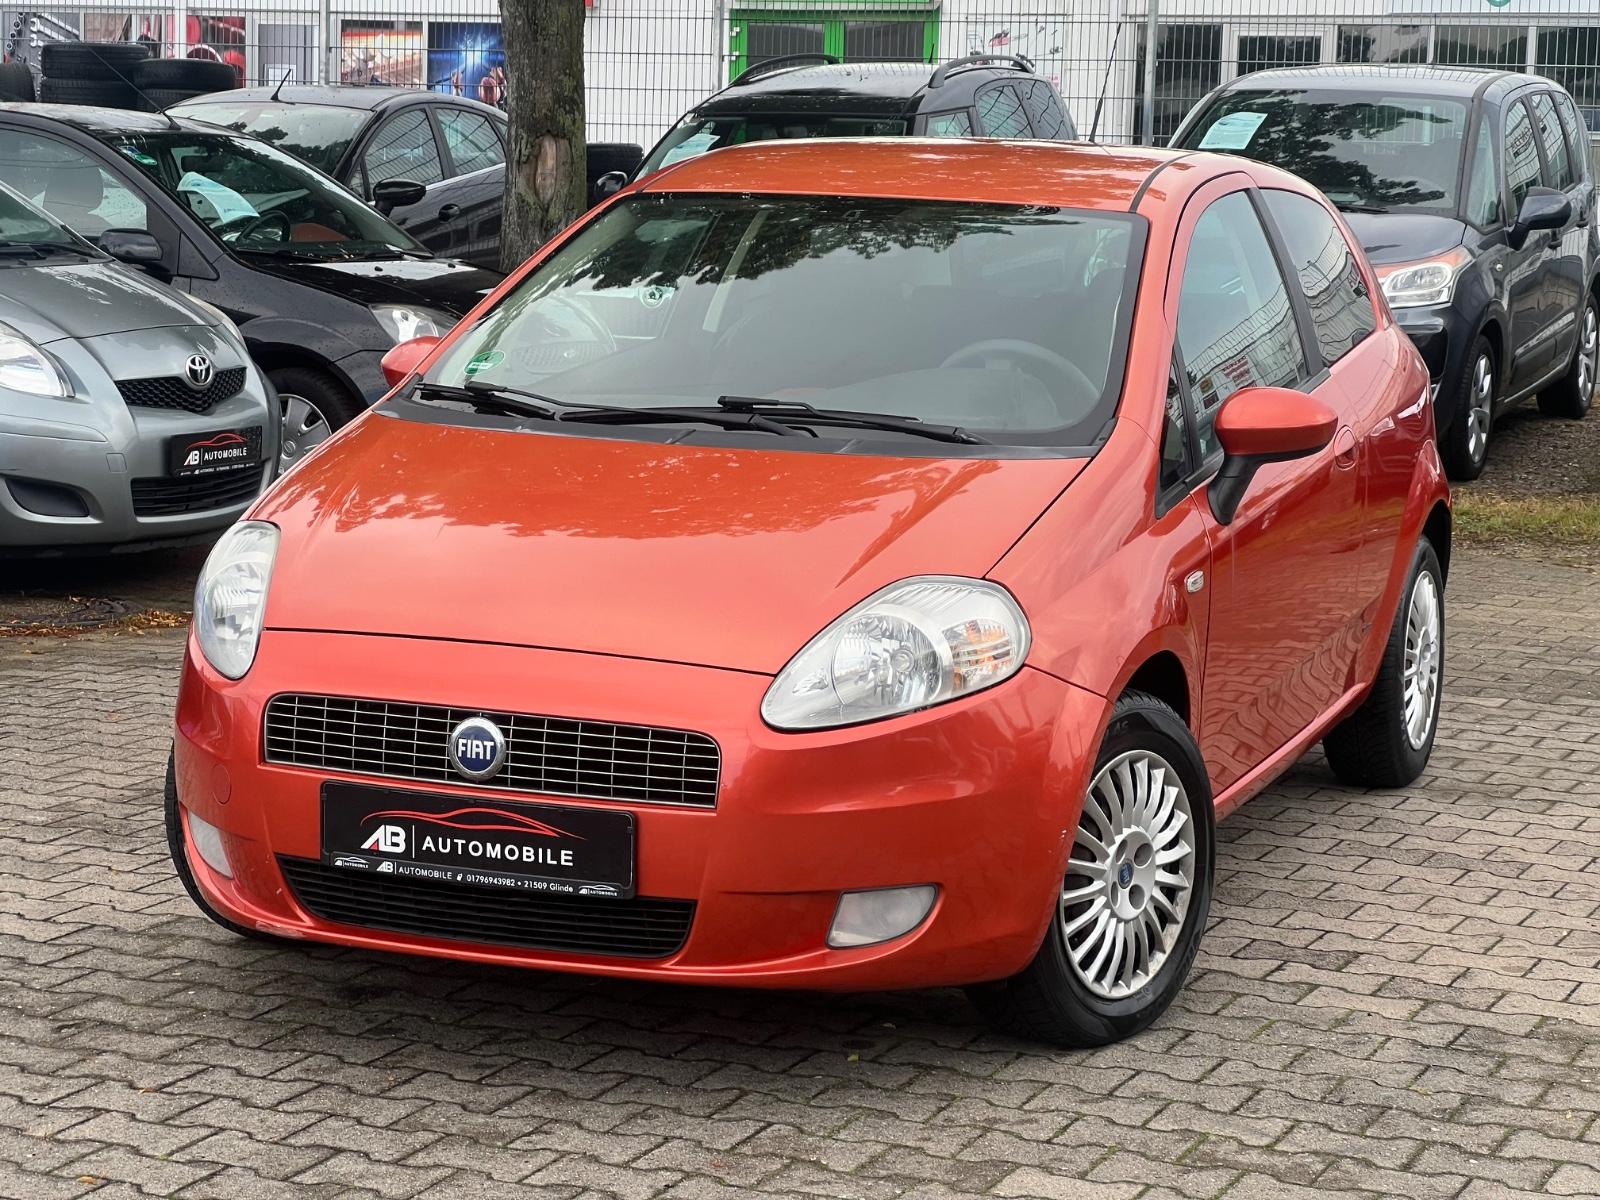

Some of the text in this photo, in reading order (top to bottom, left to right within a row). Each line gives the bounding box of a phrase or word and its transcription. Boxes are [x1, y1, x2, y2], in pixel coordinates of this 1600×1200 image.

[184, 447, 247, 465] AB AUTOMOBILE
[457, 738, 494, 760] FIAT
[360, 824, 573, 865] AB AUTOMOBILE
[376, 860, 574, 893] AB AUTOMOBILE 01796943982 21509 Glinde
